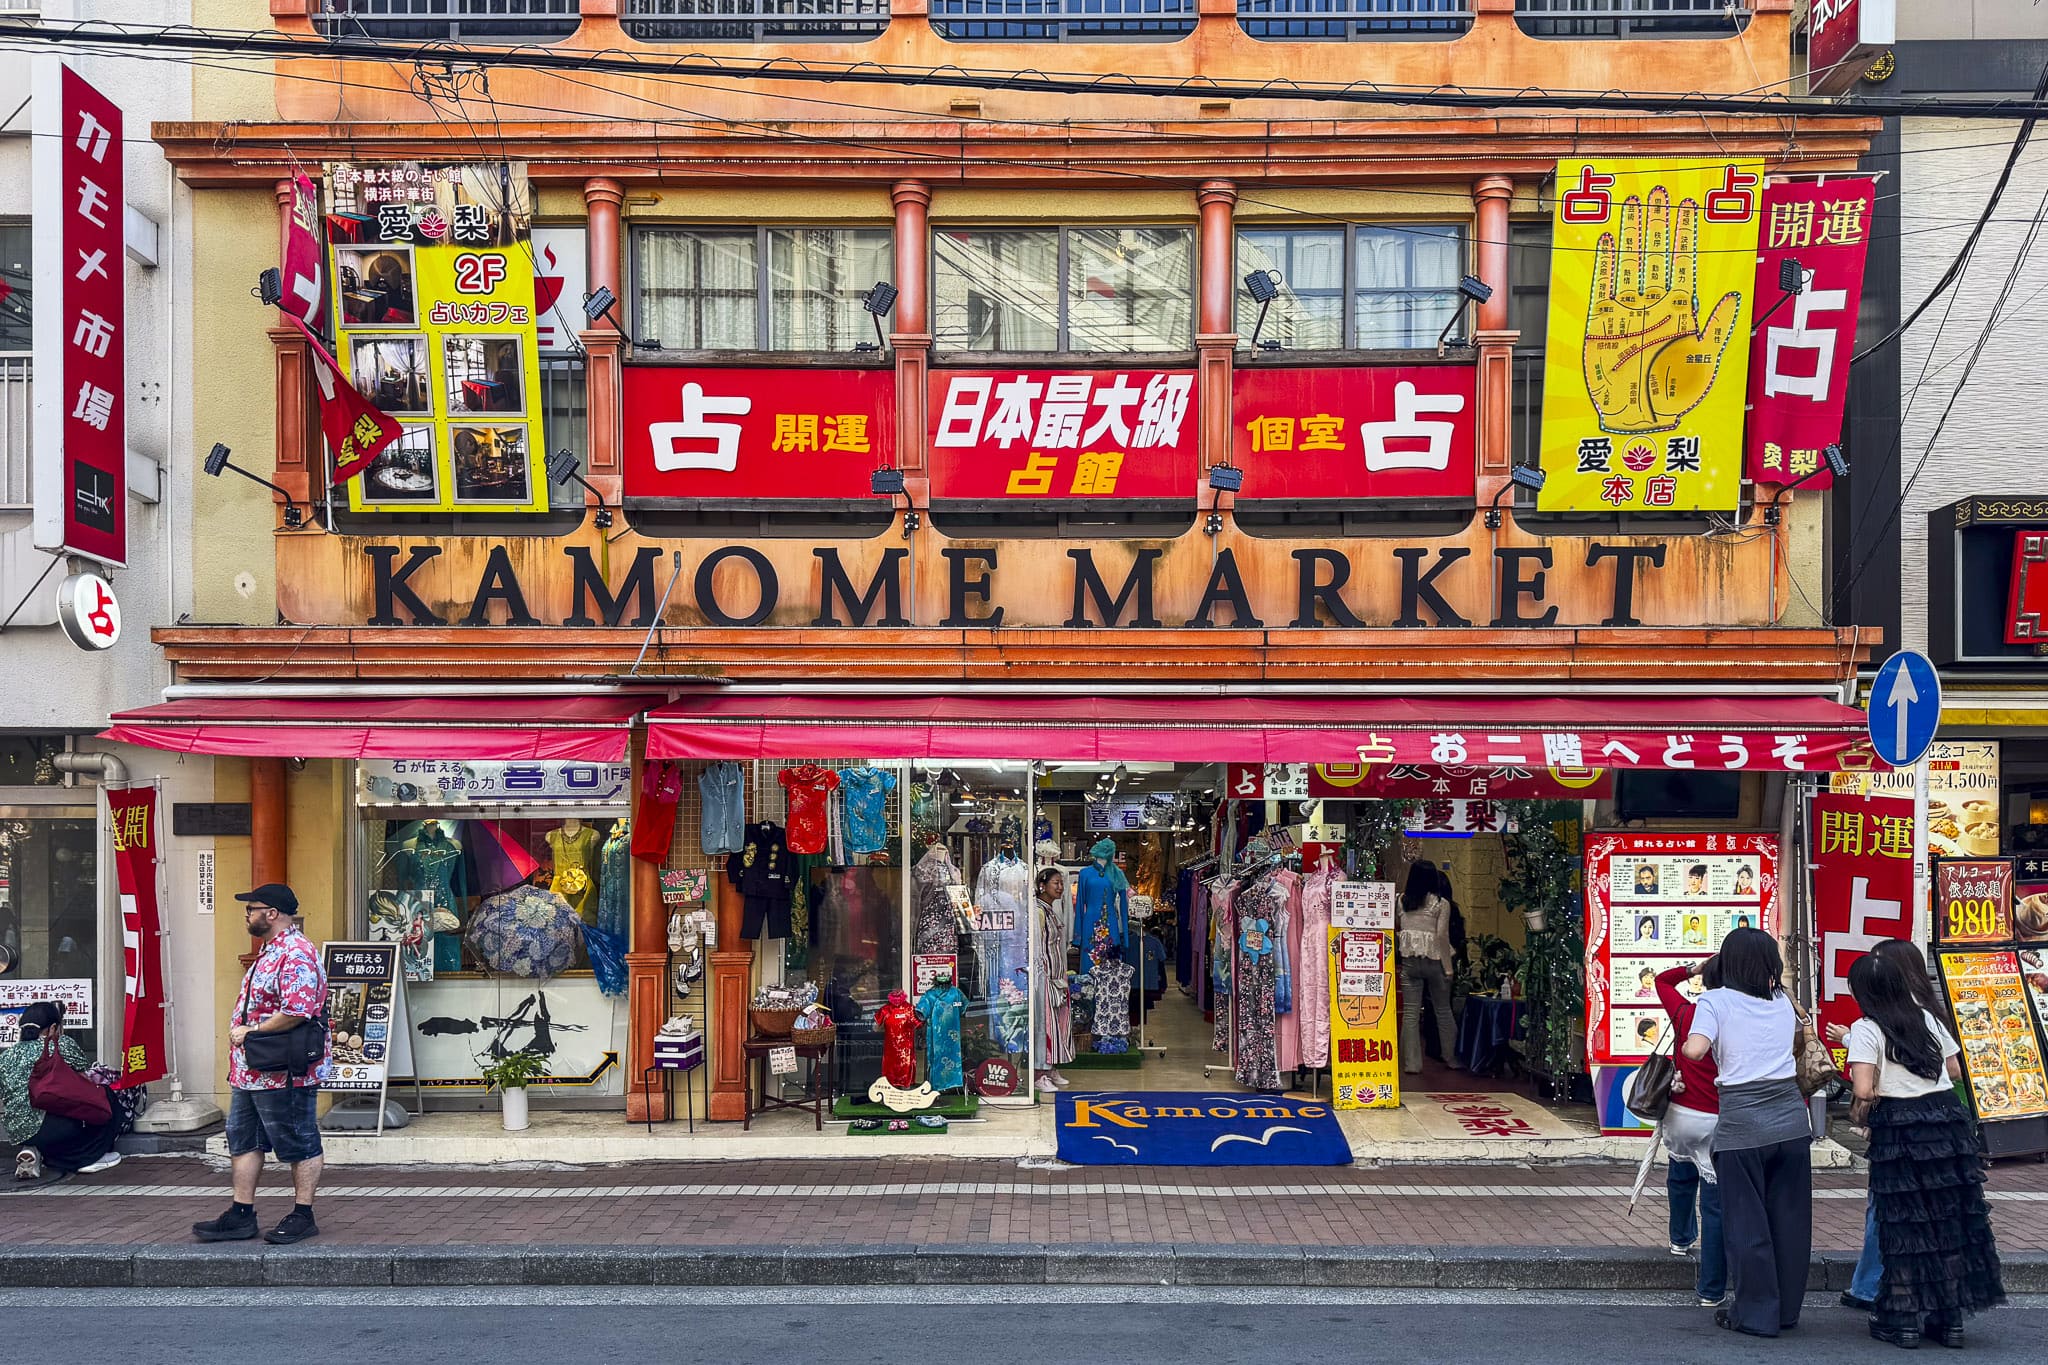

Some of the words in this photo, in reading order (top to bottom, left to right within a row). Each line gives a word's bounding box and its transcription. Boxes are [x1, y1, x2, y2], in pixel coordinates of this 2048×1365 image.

[335, 168, 462, 184] 日本最大級の占い館
[364, 186, 434, 201] 横浜中華街
[1562, 165, 1615, 223] 占
[1705, 164, 1758, 224] 占
[378, 204, 413, 241] 愛
[454, 204, 489, 240] 梨
[1769, 197, 1866, 248] 開運
[72, 110, 115, 431] カモメ市場
[454, 254, 506, 294] 2F
[429, 301, 529, 325] 占いカフェ
[1764, 269, 1847, 402] 占
[649, 382, 751, 472] 占
[772, 414, 870, 453] 開運
[935, 374, 1194, 448] 日本最大級
[1246, 413, 1346, 453] 個室
[1360, 381, 1464, 472] 占
[1577, 437, 1612, 473] 愛
[1665, 436, 1701, 473] 梨
[1763, 442, 1817, 474] 愛梨
[1005, 452, 1125, 494] 占館
[1602, 475, 1676, 506] 本店
[366, 545, 1003, 628] KAMOME
[1066, 545, 1667, 628] MARKET
[88, 579, 115, 637] 占
[1355, 732, 1397, 764] 占
[1430, 732, 1809, 770] お二階へどうぞ
[437, 776, 495, 790] 奇跡の力
[1235, 768, 1256, 795] 占
[1432, 778, 1487, 795] 本店
[1873, 773, 1915, 789] 9,000
[1821, 810, 1914, 859] 開運
[1946, 865, 2005, 880] アルコール
[1949, 881, 2001, 898] 飲み放題
[1949, 899, 1996, 936] 980
[334, 953, 383, 963] 石が伝える
[345, 964, 385, 975] 奇跡の力
[354, 1067, 369, 1080] 石
[987, 1064, 1009, 1076] We
[1339, 1084, 1353, 1101] 愛
[1378, 1083, 1393, 1100] 梨
[1064, 1100, 1327, 1128] Kamome
